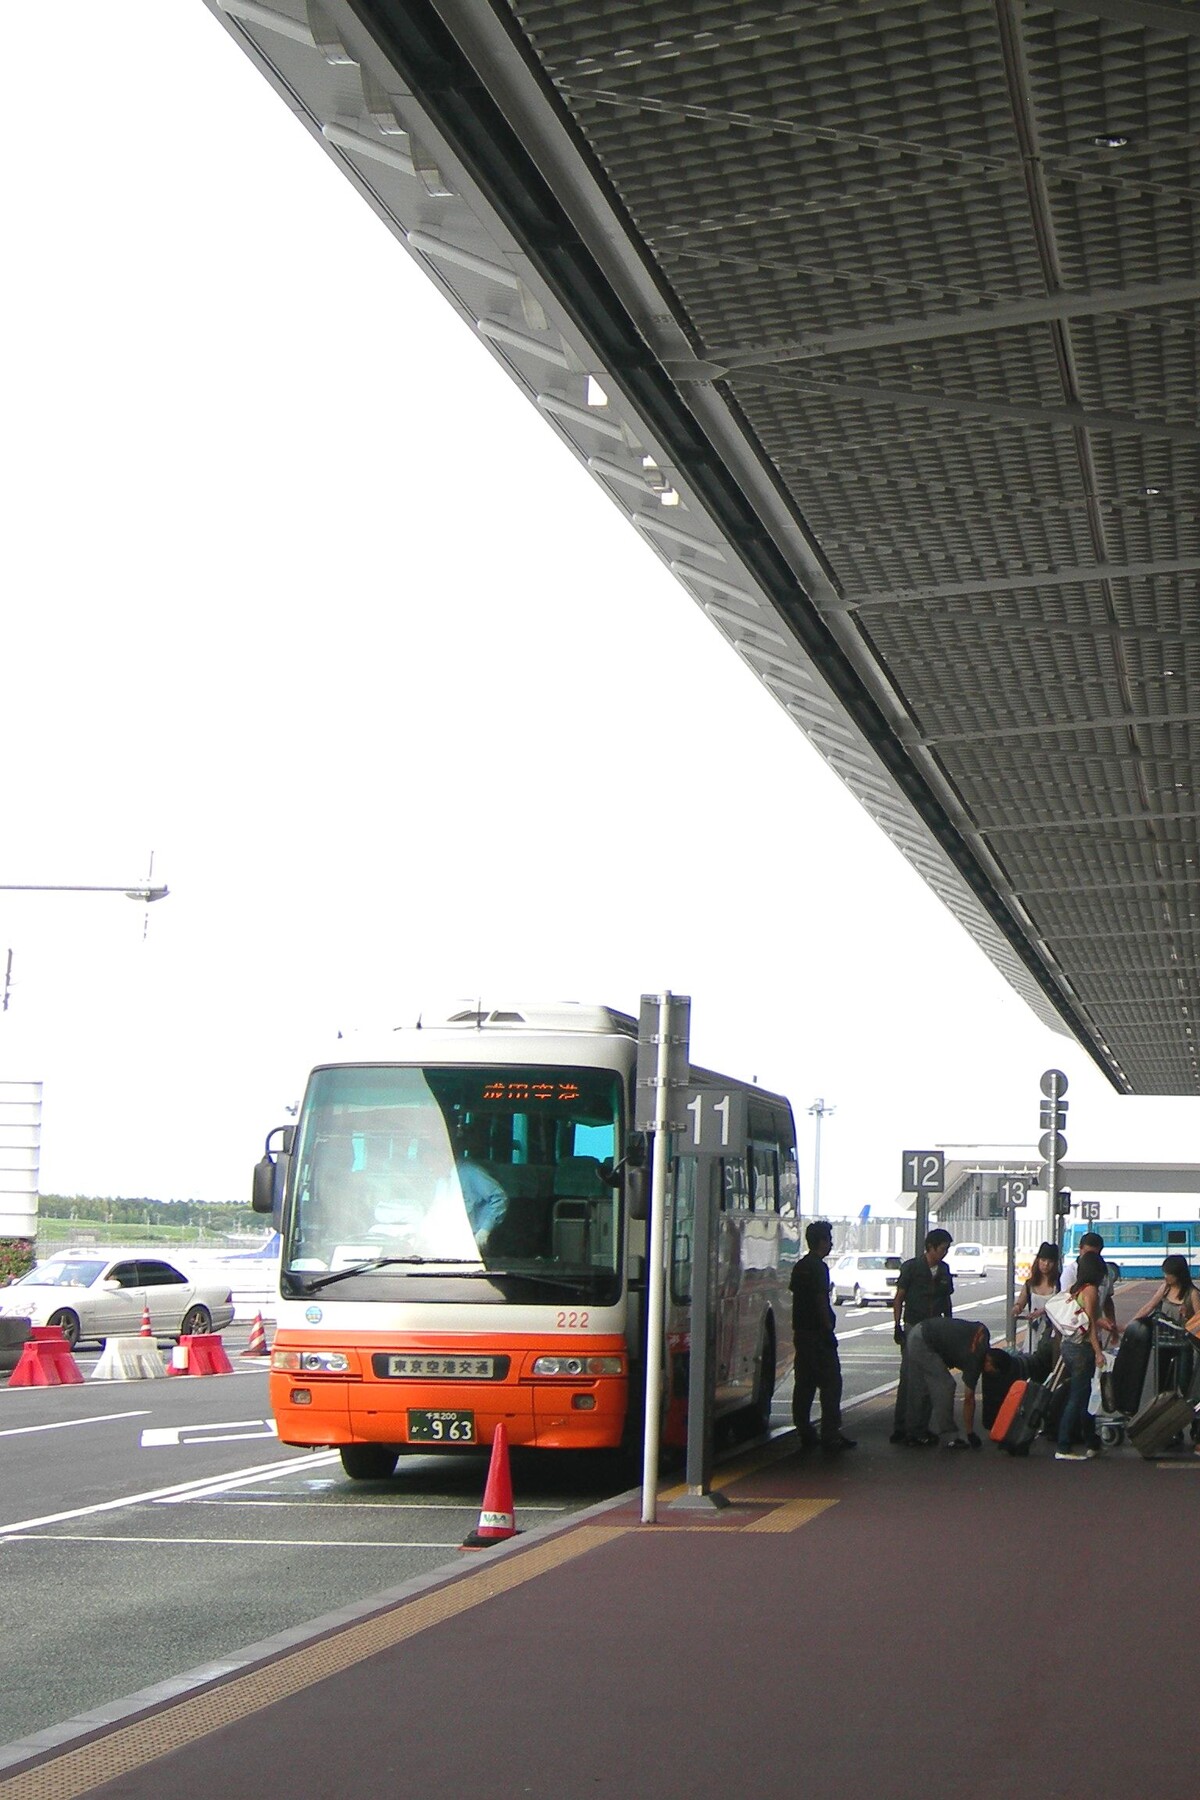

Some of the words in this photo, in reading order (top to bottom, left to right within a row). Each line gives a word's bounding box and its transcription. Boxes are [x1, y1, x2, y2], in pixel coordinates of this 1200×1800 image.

[687, 1095, 729, 1146] 11
[908, 1156, 939, 1186] 12
[1002, 1181, 1024, 1204] 13
[1083, 1203, 1098, 1218] 15
[557, 1312, 589, 1328] 222
[393, 1359, 489, 1375] 東京空港交通
